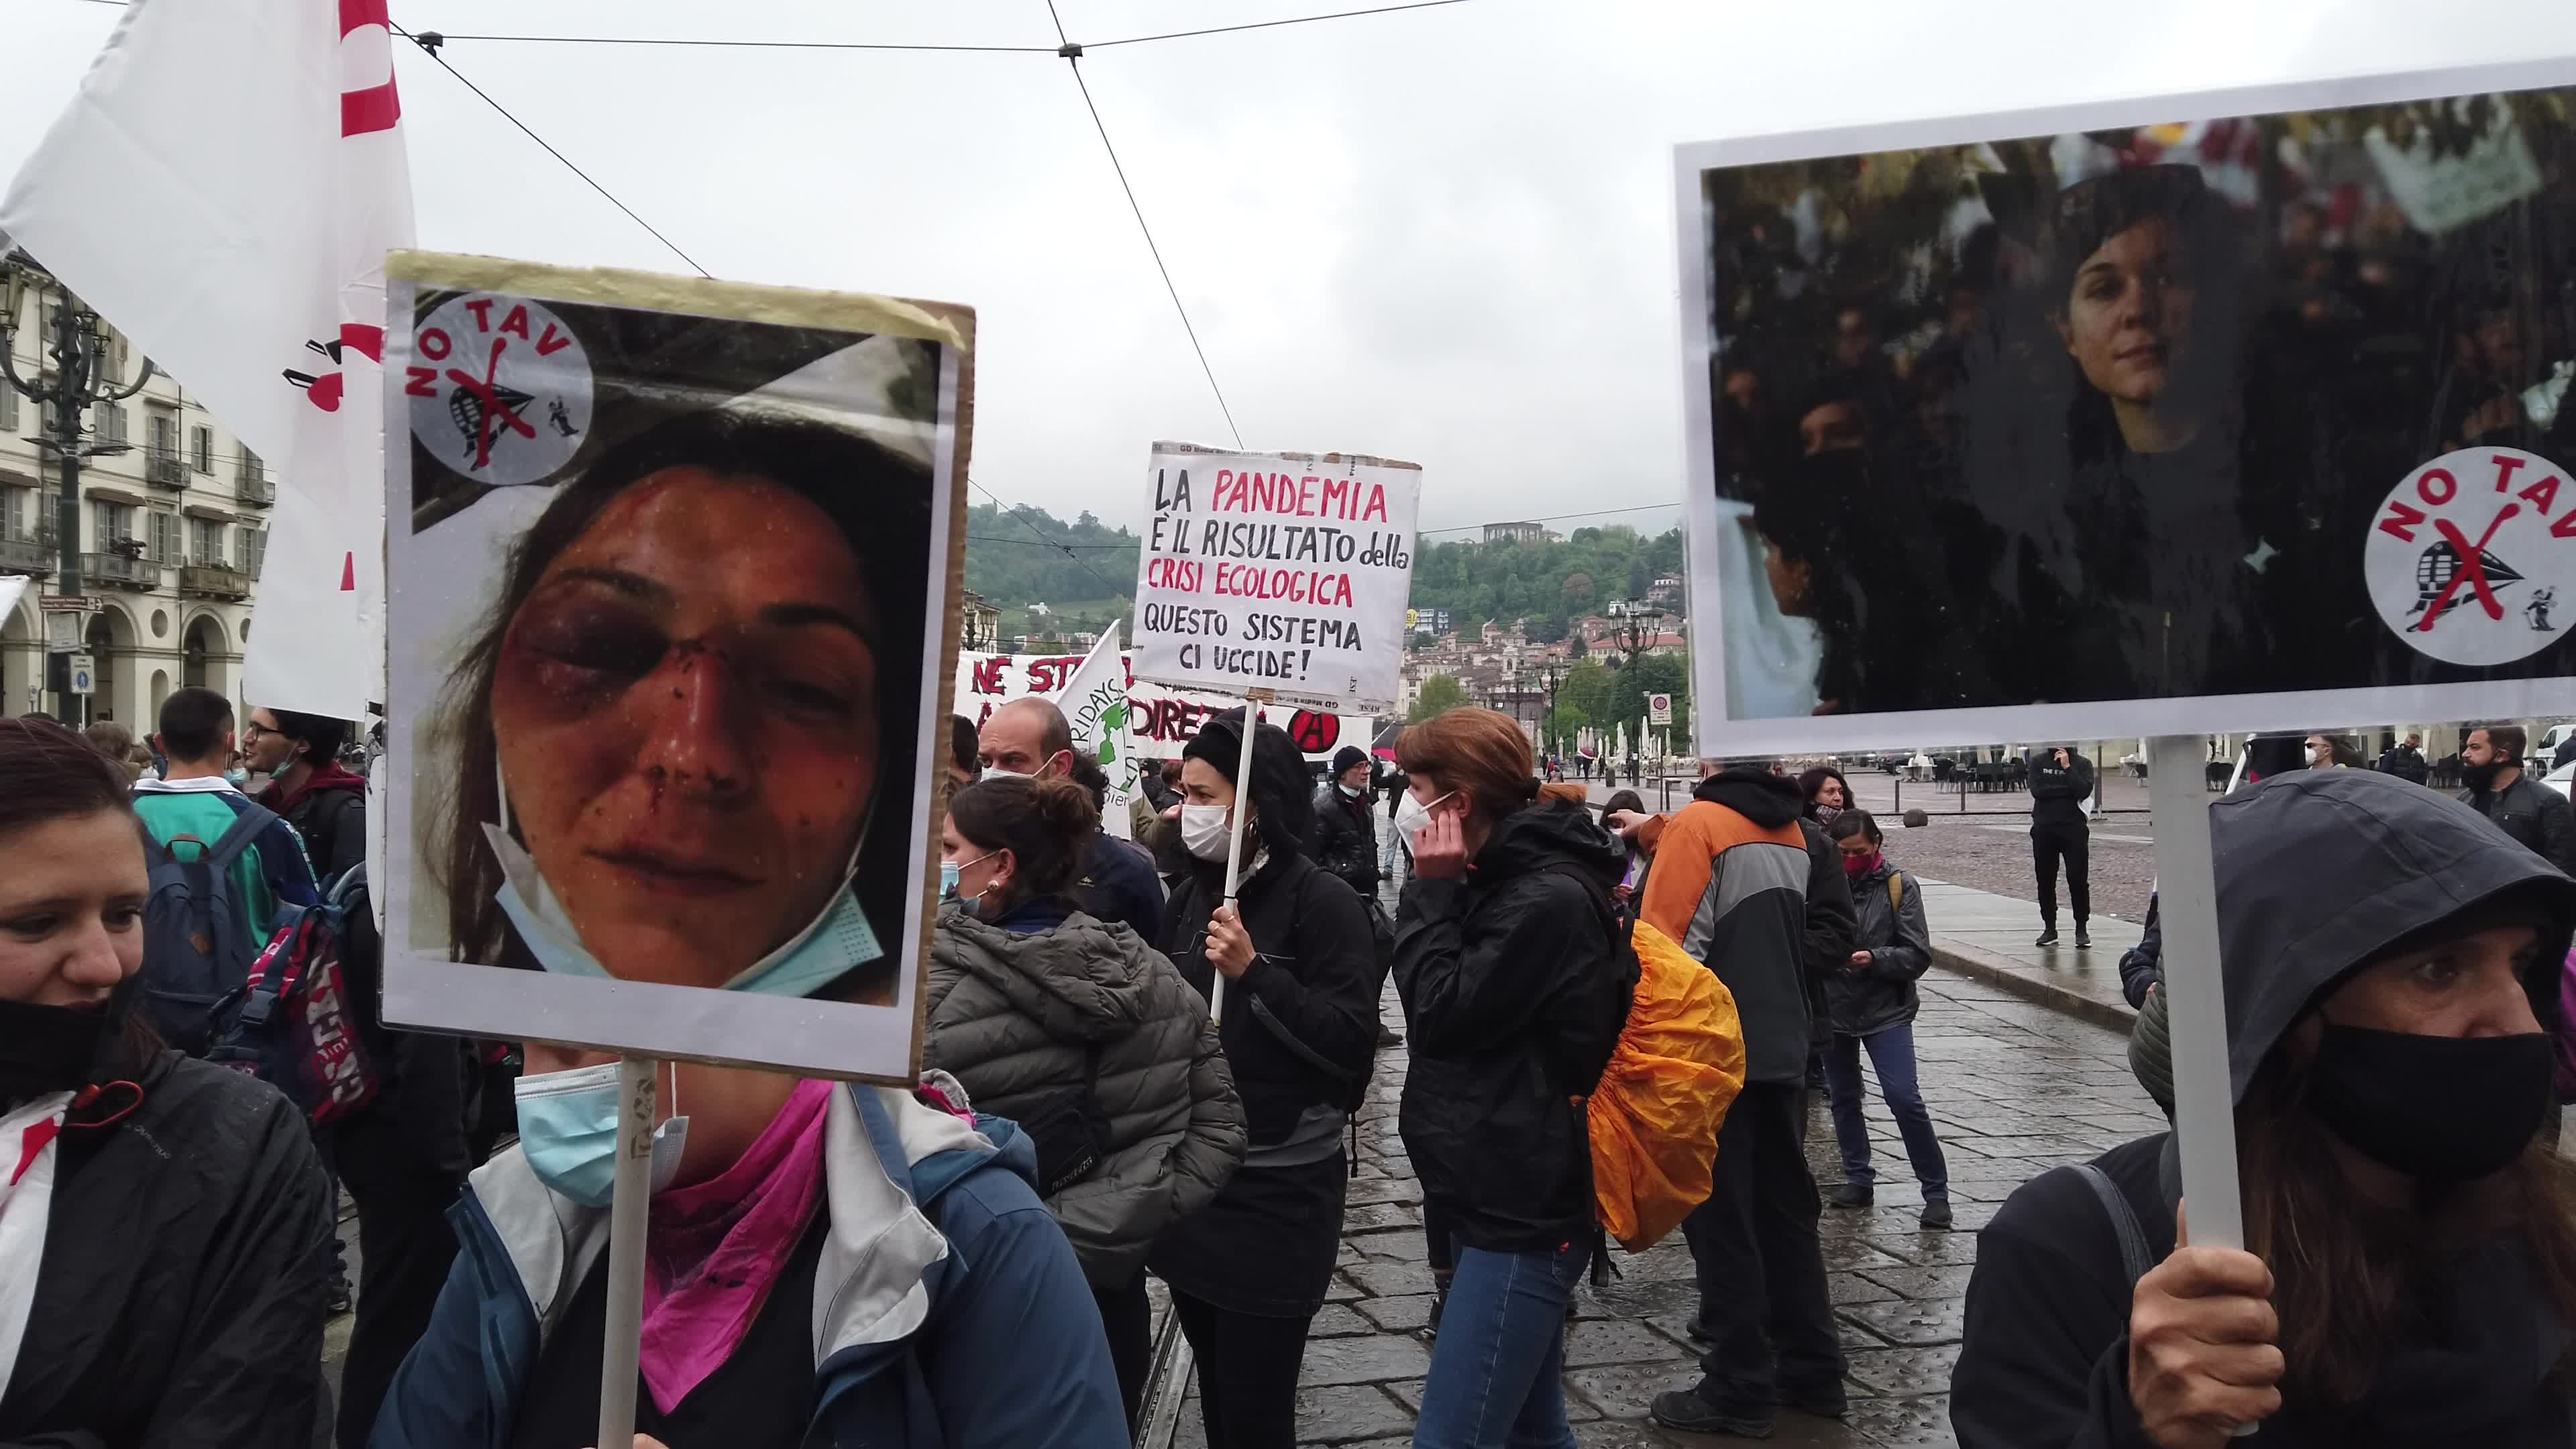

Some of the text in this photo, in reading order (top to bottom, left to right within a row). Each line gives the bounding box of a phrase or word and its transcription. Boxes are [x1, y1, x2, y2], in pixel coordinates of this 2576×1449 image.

[405, 299, 571, 397] NO TAV
[1155, 468, 1387, 523] LA PANDEMIA
[2378, 468, 2457, 543] NO
[1150, 513, 1409, 570] È IL RISULTATO della
[1148, 558, 1352, 608] CRISI ECOLOGICA
[1144, 603, 1362, 651] QUESTO SISTEMA
[971, 655, 1013, 695] NE
[1179, 644, 1311, 682] CI UCCIDE!
[1071, 678, 1120, 742] RIDAYS
